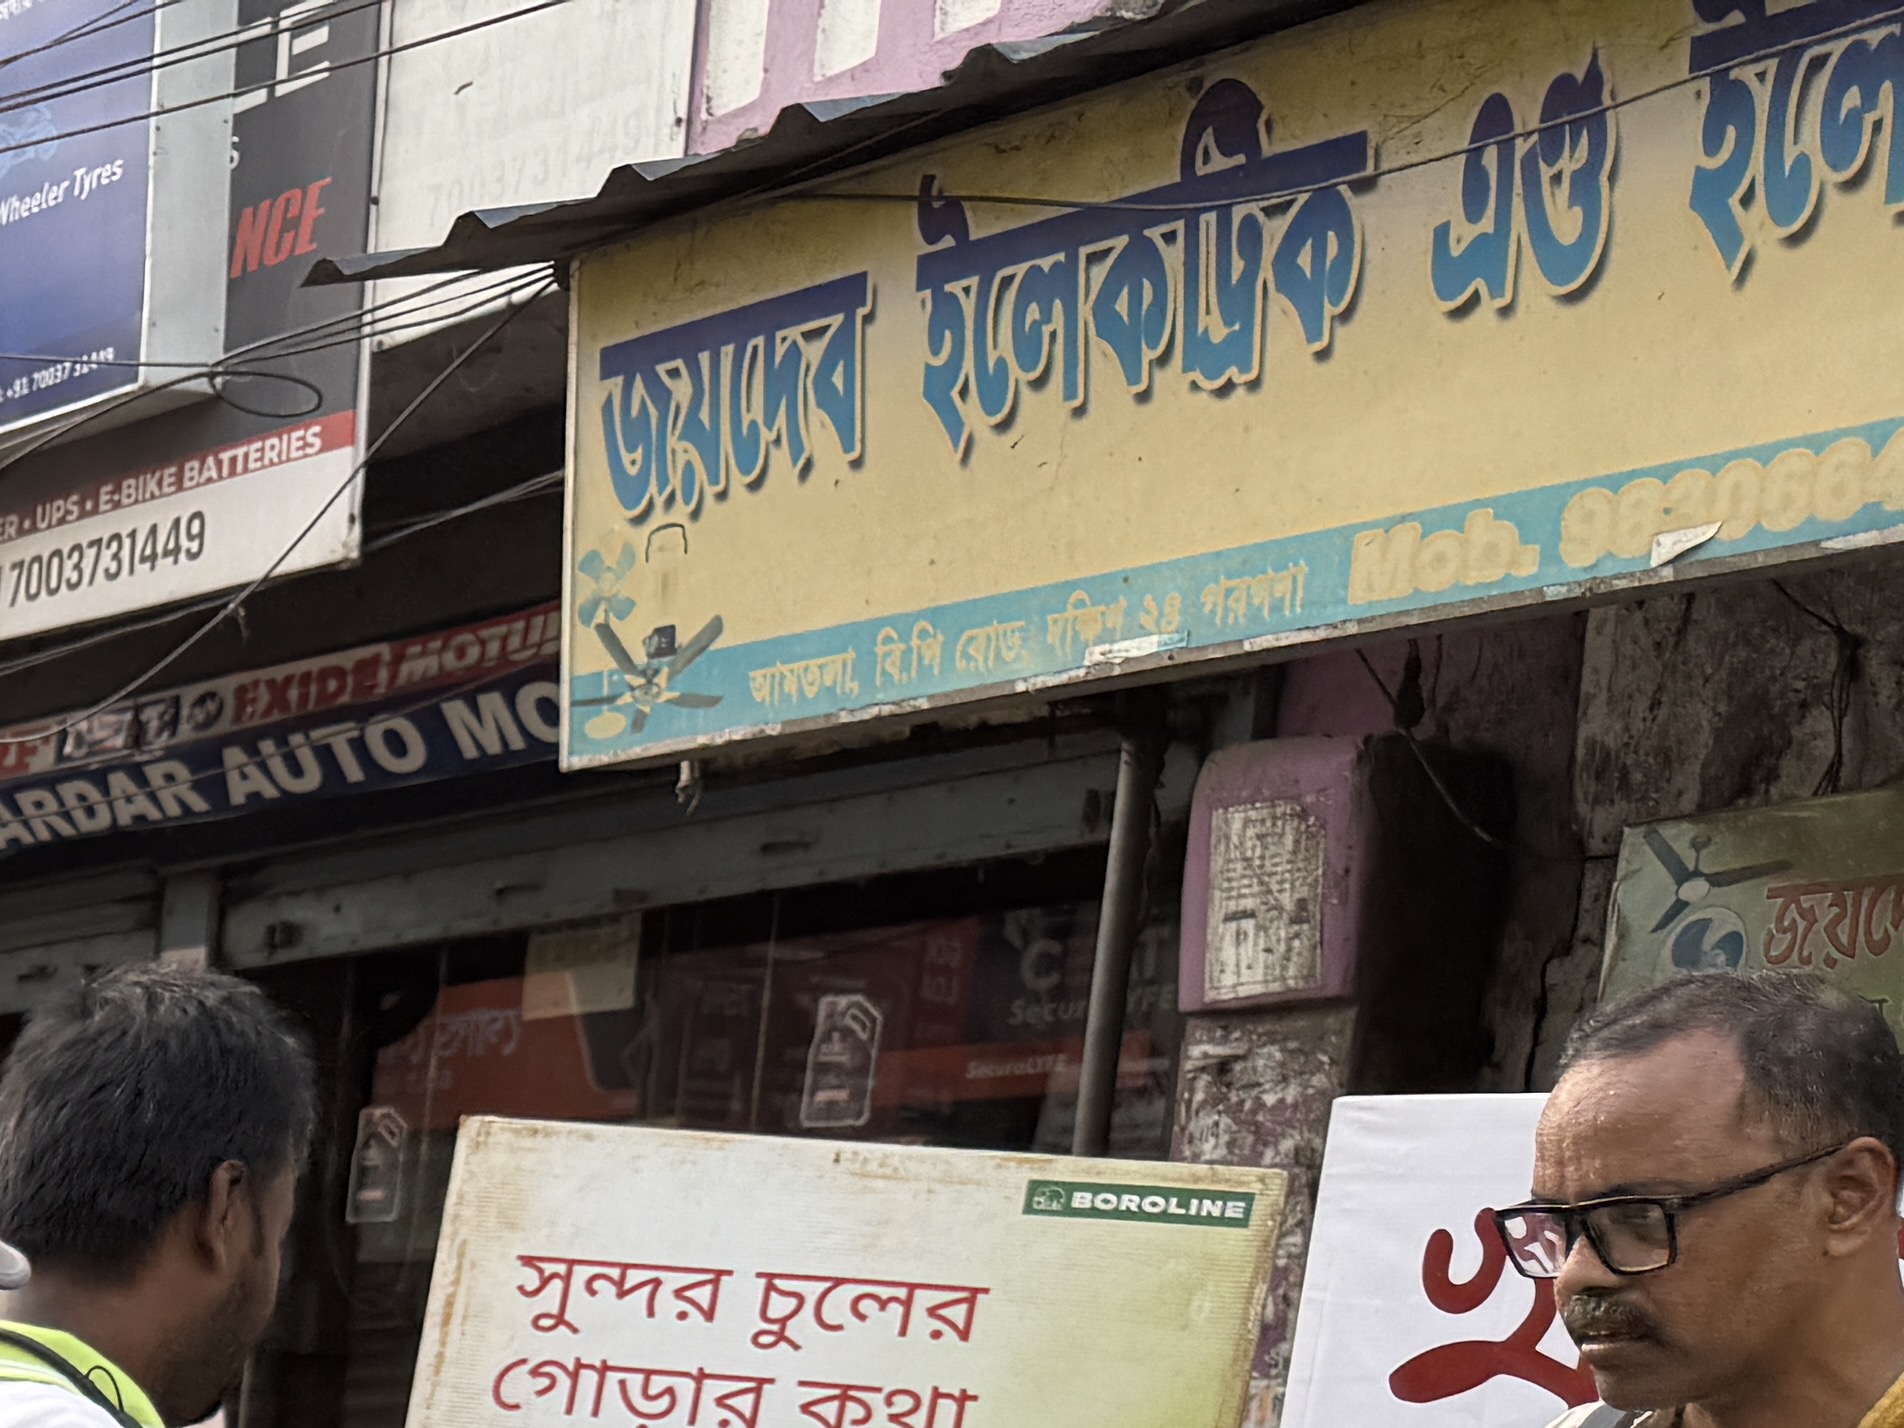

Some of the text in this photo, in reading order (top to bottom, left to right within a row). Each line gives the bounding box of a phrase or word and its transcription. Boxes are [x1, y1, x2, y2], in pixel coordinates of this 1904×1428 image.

[72, 157, 123, 203] Tyres
[598, 272, 870, 518] জয়দেব
[36, 496, 83, 531] UPS
[97, 468, 176, 515] E-BIKE
[181, 425, 323, 490] BATTERIES
[7, 510, 206, 607] 7003731449
[1347, 507, 1540, 605] Mob.
[231, 647, 373, 724] EXIDE
[224, 709, 427, 805] AUTO
[1071, 1191, 1247, 1219] BOROLINE
[517, 1254, 990, 1353] সুন্দর চুলের
